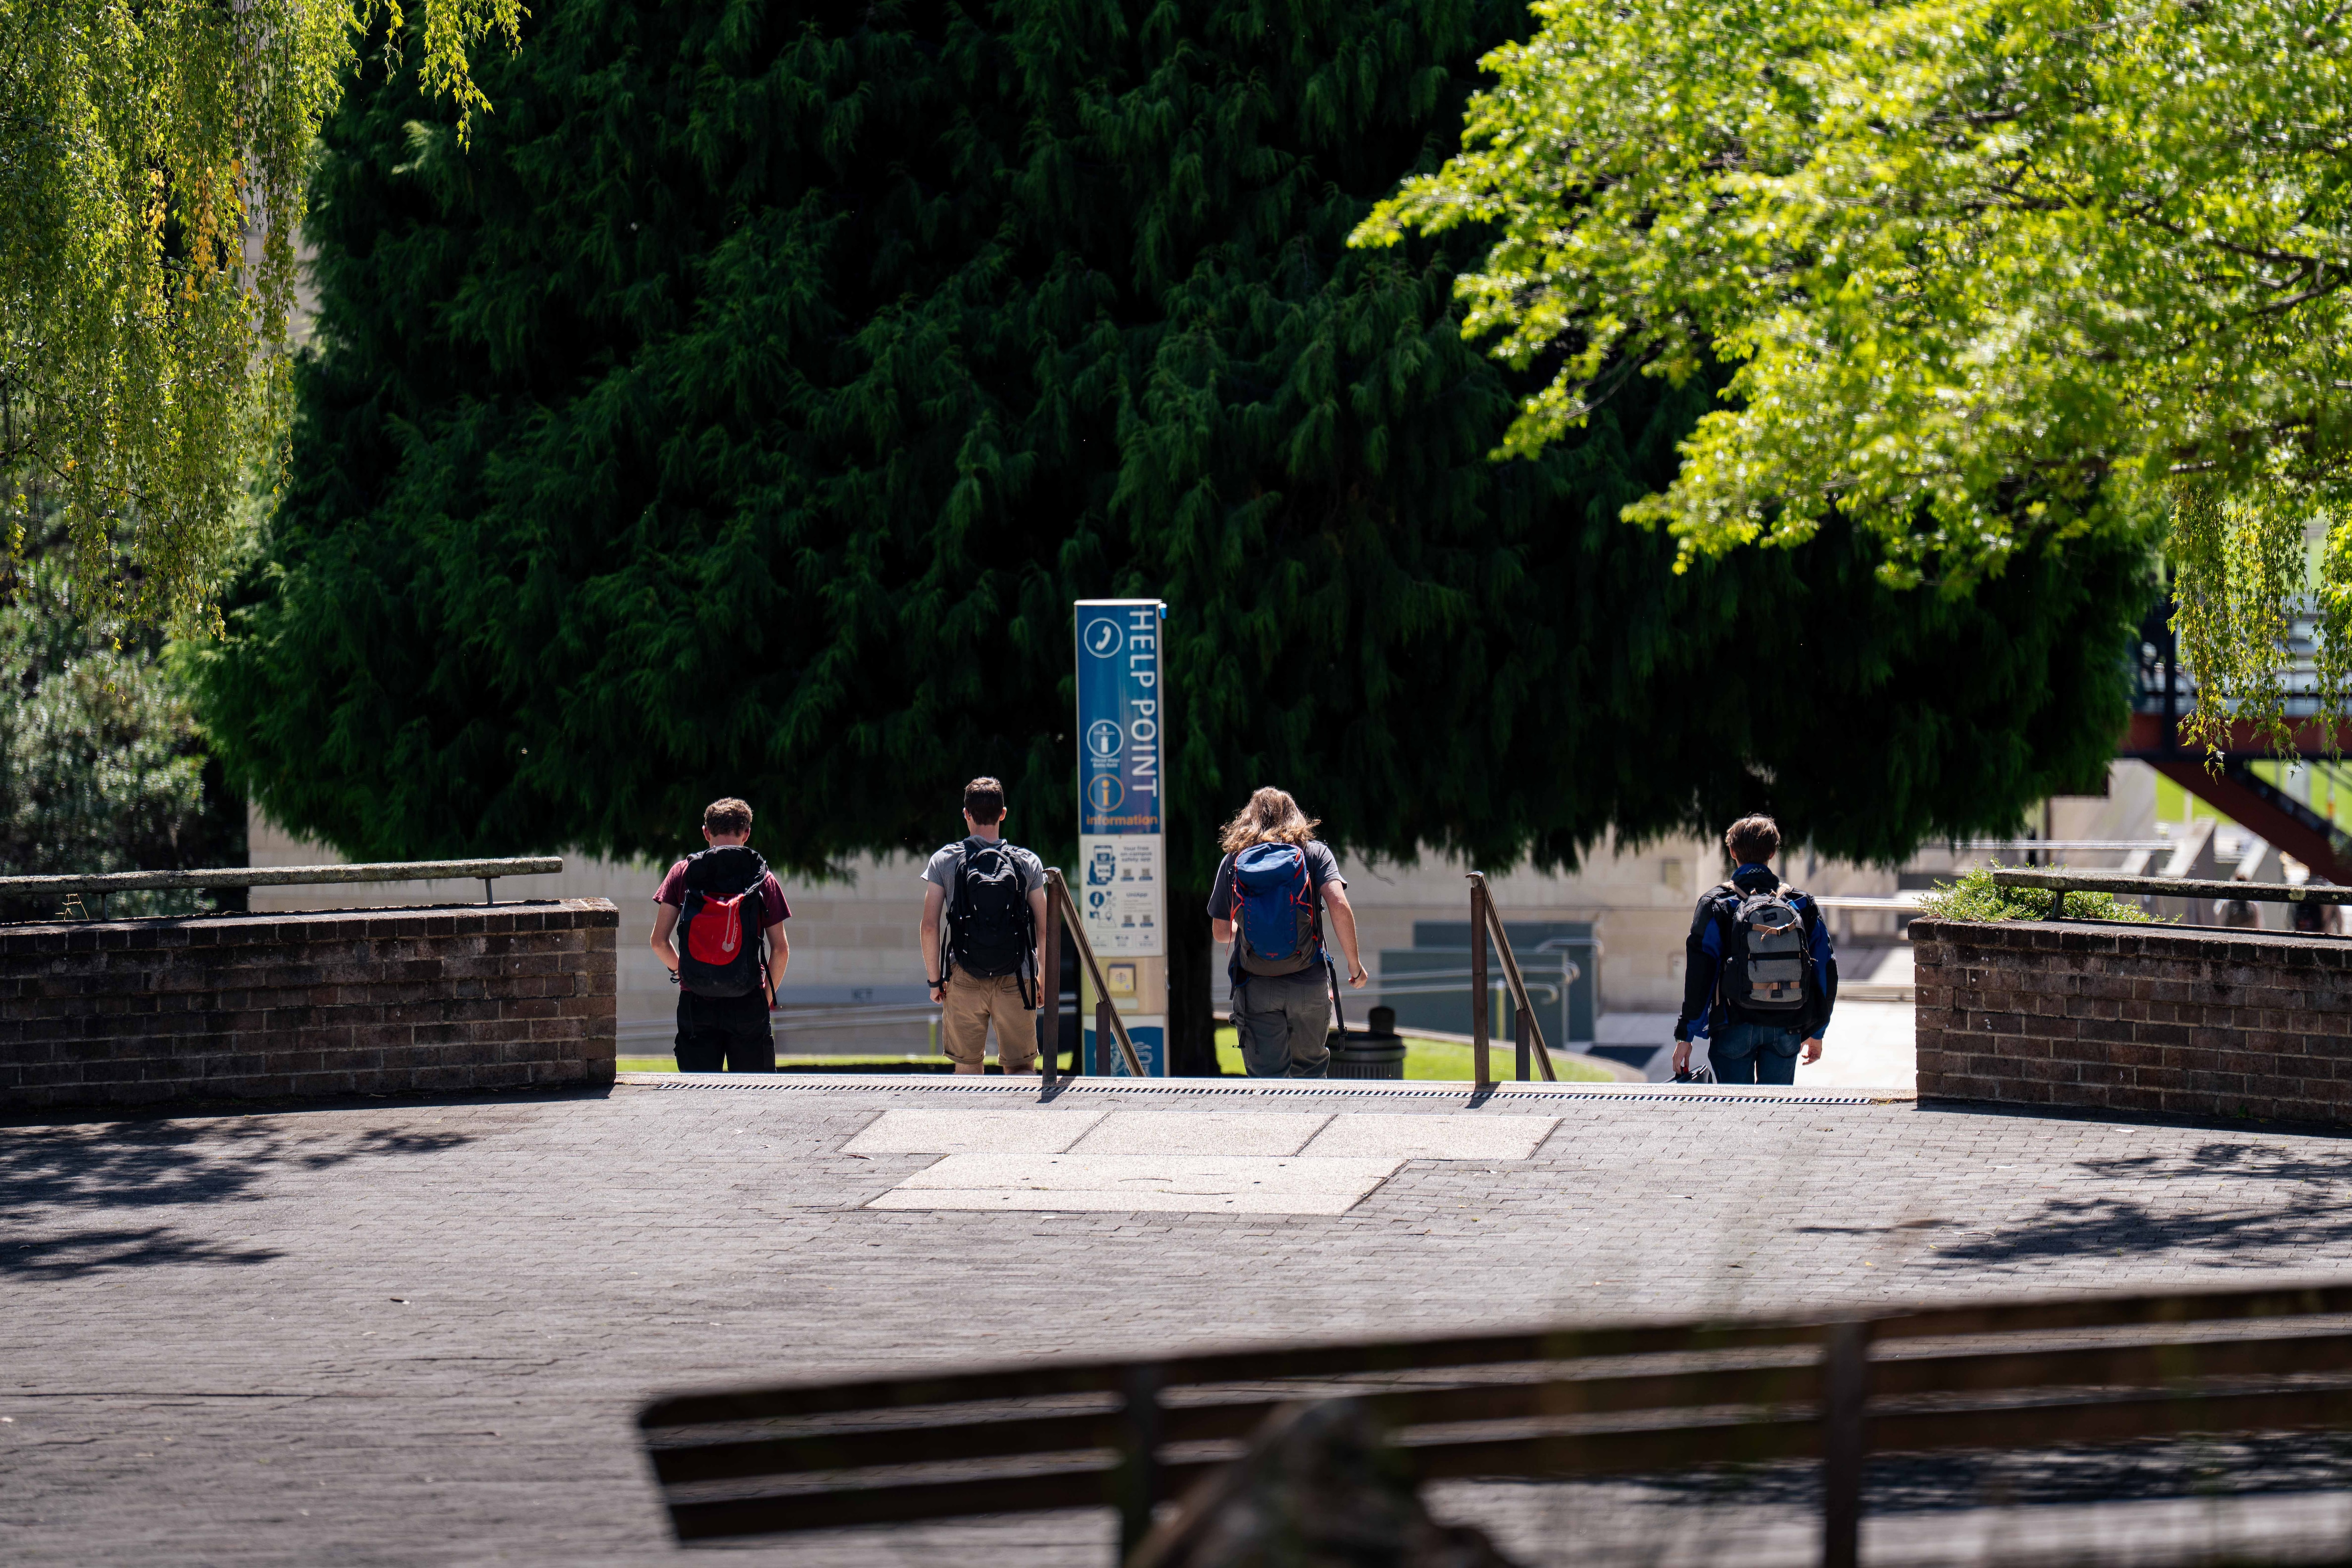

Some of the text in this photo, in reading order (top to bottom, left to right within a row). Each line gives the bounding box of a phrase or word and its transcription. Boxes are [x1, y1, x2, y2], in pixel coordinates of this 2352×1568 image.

[1129, 611, 1157, 797] HELP POINT
[1087, 814, 1158, 825] information
